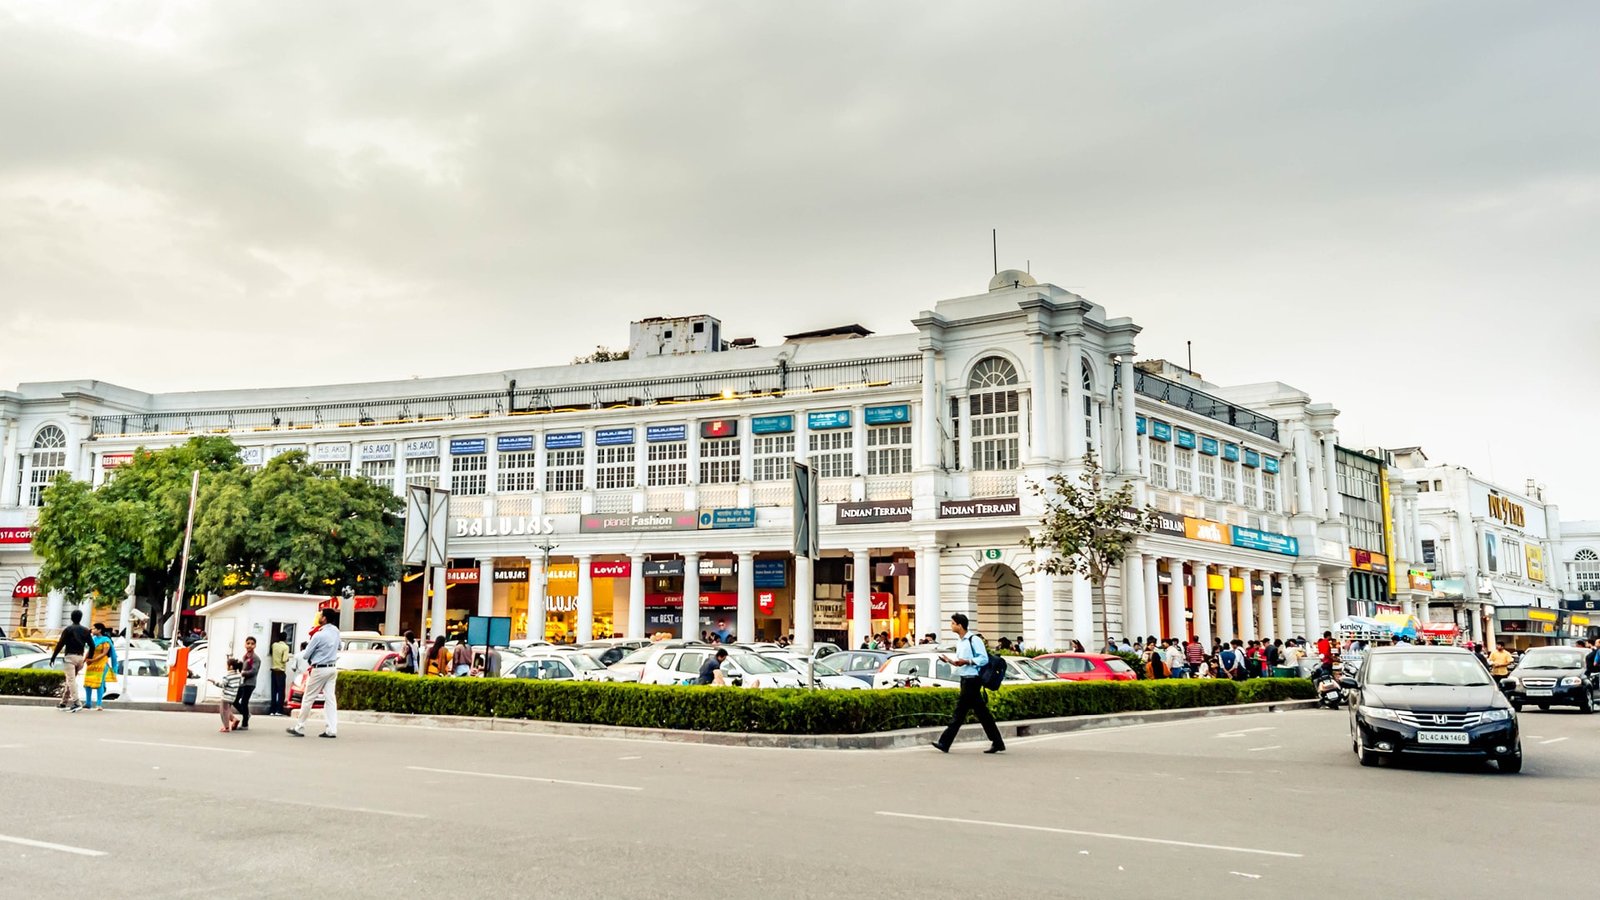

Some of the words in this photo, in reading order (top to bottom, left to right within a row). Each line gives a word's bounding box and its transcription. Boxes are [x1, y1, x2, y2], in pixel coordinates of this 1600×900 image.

[841, 509, 872, 518] INDIAN
[873, 506, 912, 516] TERRAIN
[942, 505, 974, 515] INDIAN
[975, 503, 1016, 513] TERRAIN
[456, 516, 554, 537] BALUJAS
[604, 518, 630, 528] planet
[632, 515, 672, 525] Fashion
[448, 571, 478, 580] BALUJAS
[495, 571, 526, 579] BALUJAS
[660, 614, 674, 624] BEST
